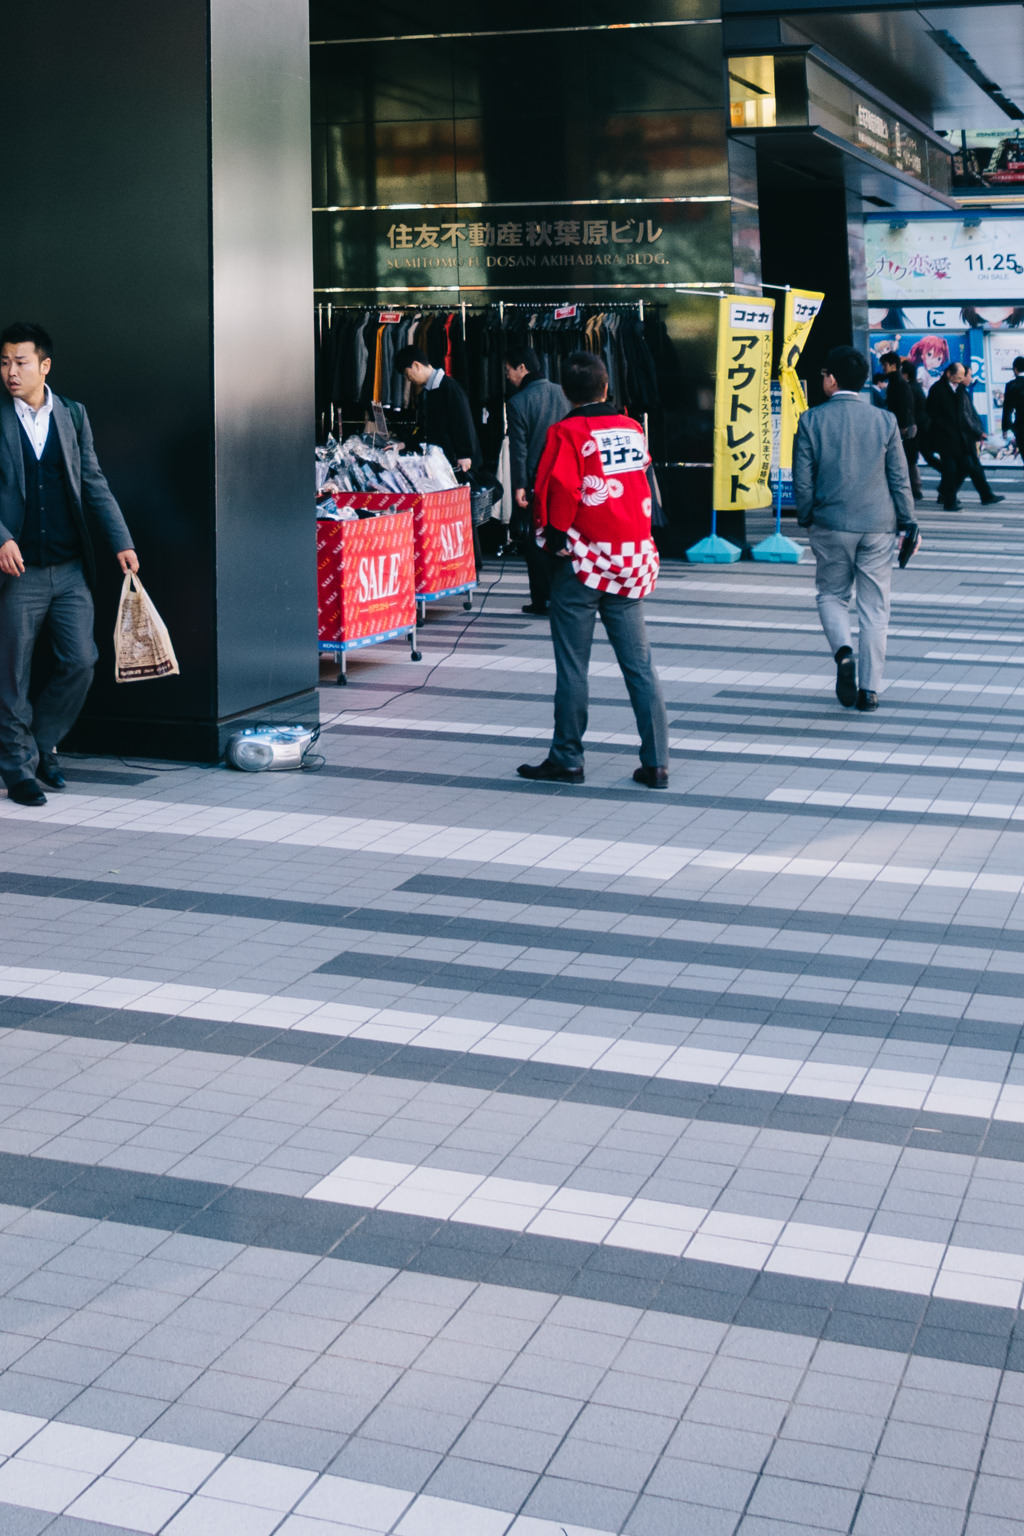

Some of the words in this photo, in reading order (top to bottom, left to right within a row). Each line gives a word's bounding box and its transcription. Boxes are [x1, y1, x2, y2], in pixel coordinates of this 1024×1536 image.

[386, 218, 663, 249] 住友不動産秋葉原ビル
[542, 252, 620, 267] AKIHABARA
[626, 252, 670, 266] BLDG.
[965, 253, 1017, 272] 11.25
[734, 309, 769, 324] コナカ
[927, 310, 946, 328] に
[726, 335, 760, 503] アウトレット
[440, 521, 465, 561] SALE
[358, 553, 401, 603] SALE
